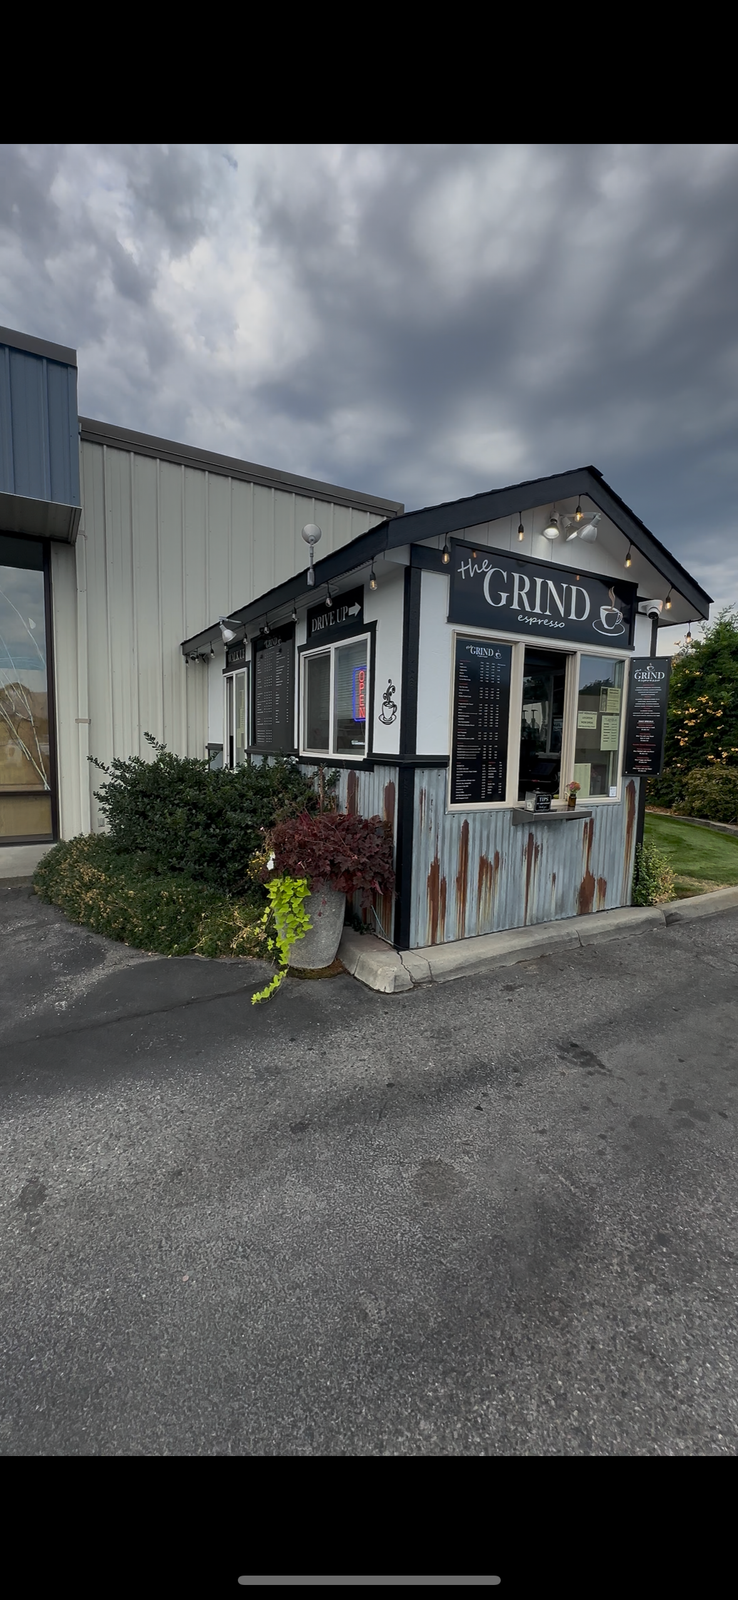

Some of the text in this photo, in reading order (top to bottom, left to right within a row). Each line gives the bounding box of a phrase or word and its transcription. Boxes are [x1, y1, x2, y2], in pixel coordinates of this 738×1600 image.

[457, 558, 492, 580] the
[483, 567, 591, 621] GRIND
[311, 605, 349, 633] DRIVE UP
[517, 614, 566, 629] espresso
[470, 646, 494, 657] GRIND
[634, 671, 665, 680] GRIND
[358, 670, 366, 718] OPEN
